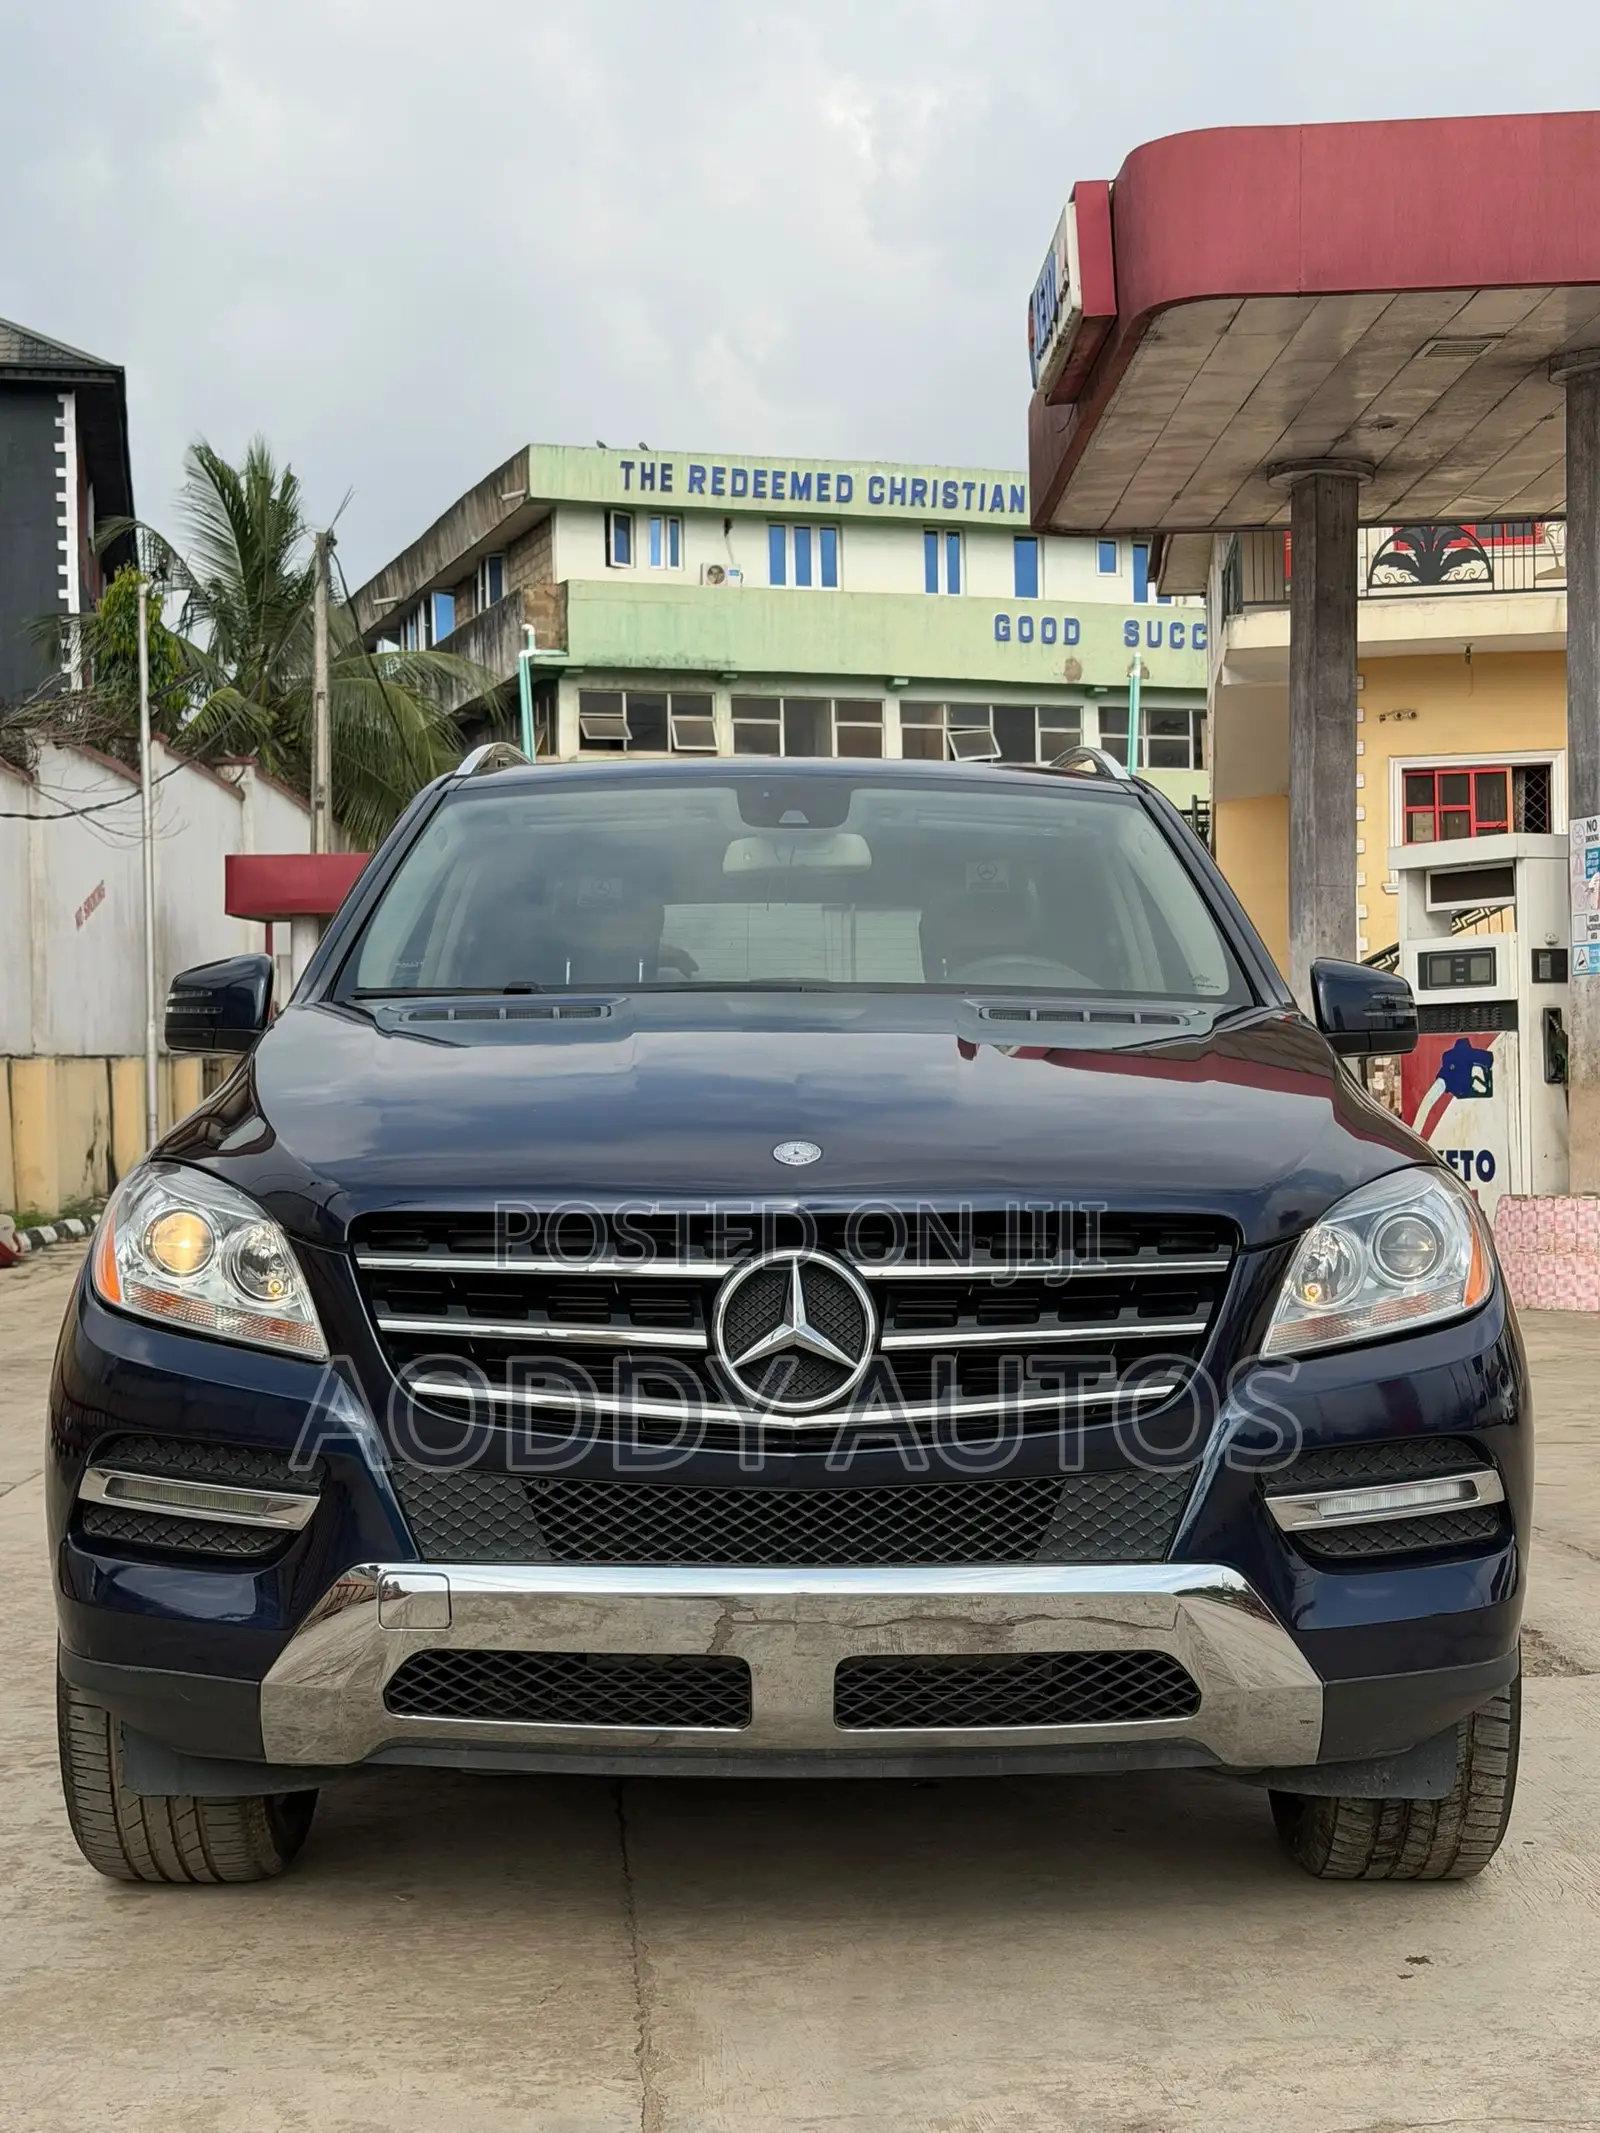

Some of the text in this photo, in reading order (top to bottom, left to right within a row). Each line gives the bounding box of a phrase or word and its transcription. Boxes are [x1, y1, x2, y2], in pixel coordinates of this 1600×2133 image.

[620, 460, 1026, 514] THE REDEEMED CHRISTIAN
[994, 613, 1081, 646] GOOD
[1586, 819, 1598, 834] NO
